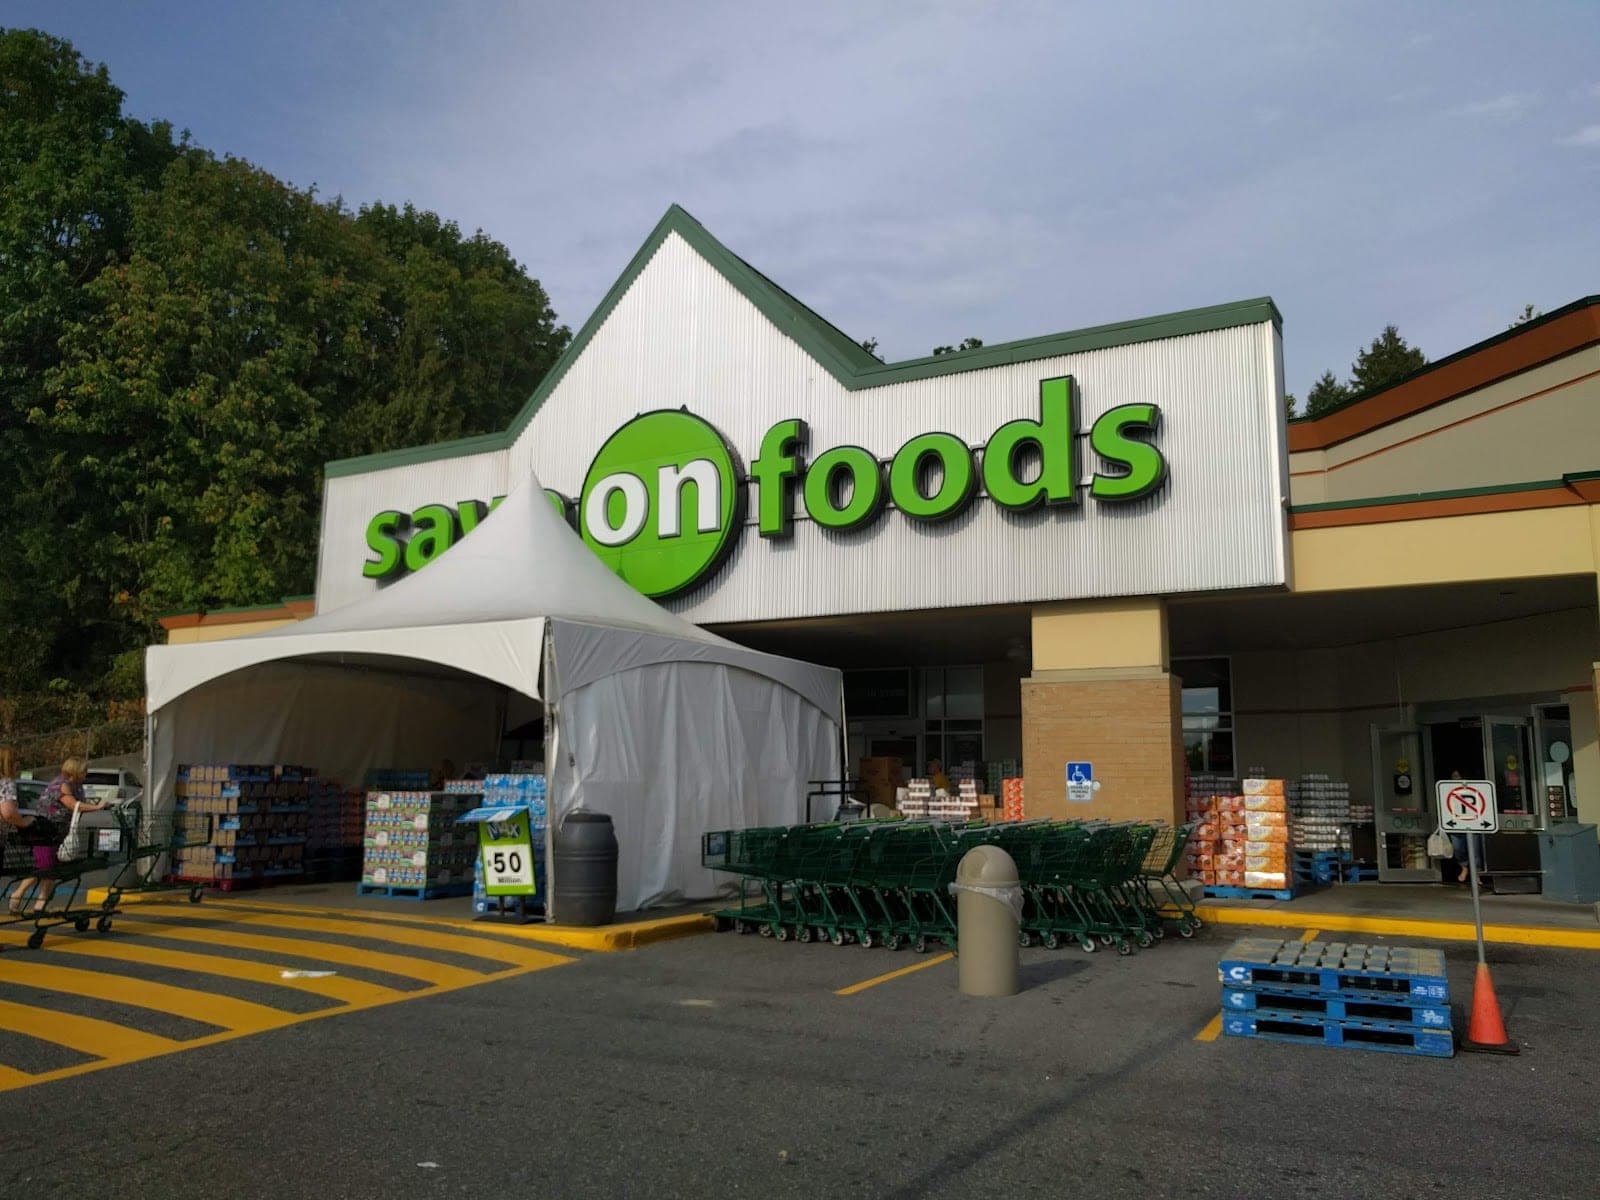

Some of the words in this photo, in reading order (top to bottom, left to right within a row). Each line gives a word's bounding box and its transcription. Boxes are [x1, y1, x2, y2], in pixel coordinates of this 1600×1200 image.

[363, 488, 566, 579] sa
[585, 458, 721, 547] on
[751, 375, 1166, 538] foods
